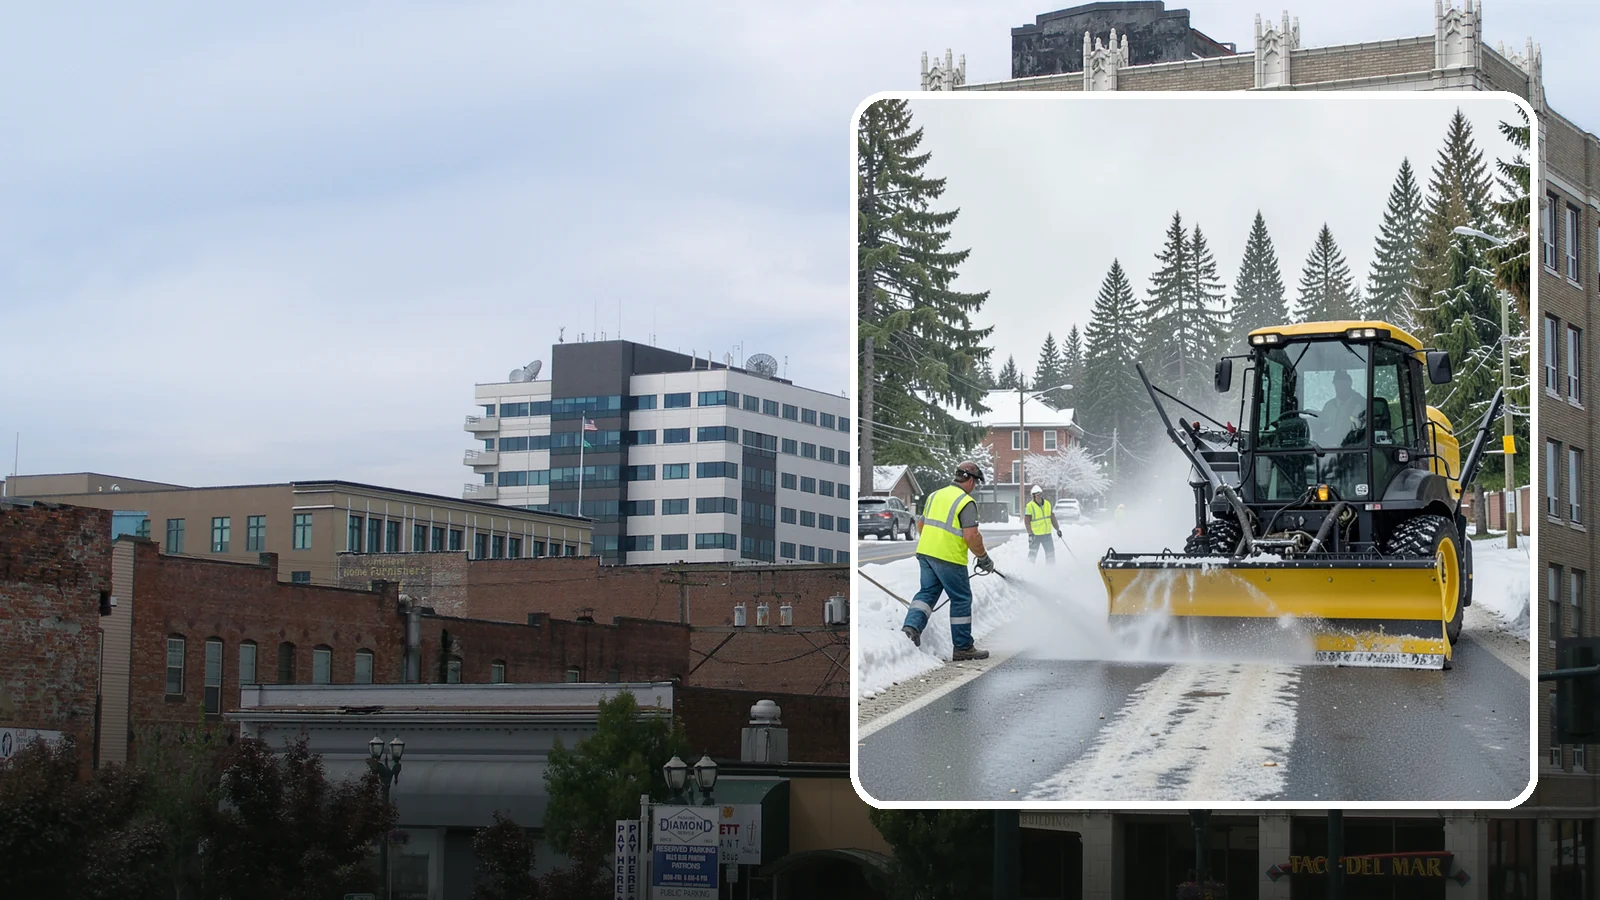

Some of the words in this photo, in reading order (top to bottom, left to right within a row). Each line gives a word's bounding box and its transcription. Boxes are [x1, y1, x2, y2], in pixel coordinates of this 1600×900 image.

[343, 568, 368, 577] Home
[371, 566, 427, 576] Furnishers
[660, 818, 713, 833] DIAMOND
[1022, 815, 1070, 828] BUILDING
[617, 825, 625, 852] PAY
[629, 824, 637, 852] PAY
[656, 845, 688, 853] RESERVED
[689, 846, 716, 854] PARKING
[721, 851, 739, 863] Soup
[671, 862, 701, 870] PATRONS
[1345, 856, 1385, 875] DEL
[1392, 857, 1442, 877] MAR
[617, 856, 625, 893] HERE
[628, 856, 636, 893] HERE
[660, 889, 682, 897] PUBLIC
[683, 889, 710, 898] PARKING
